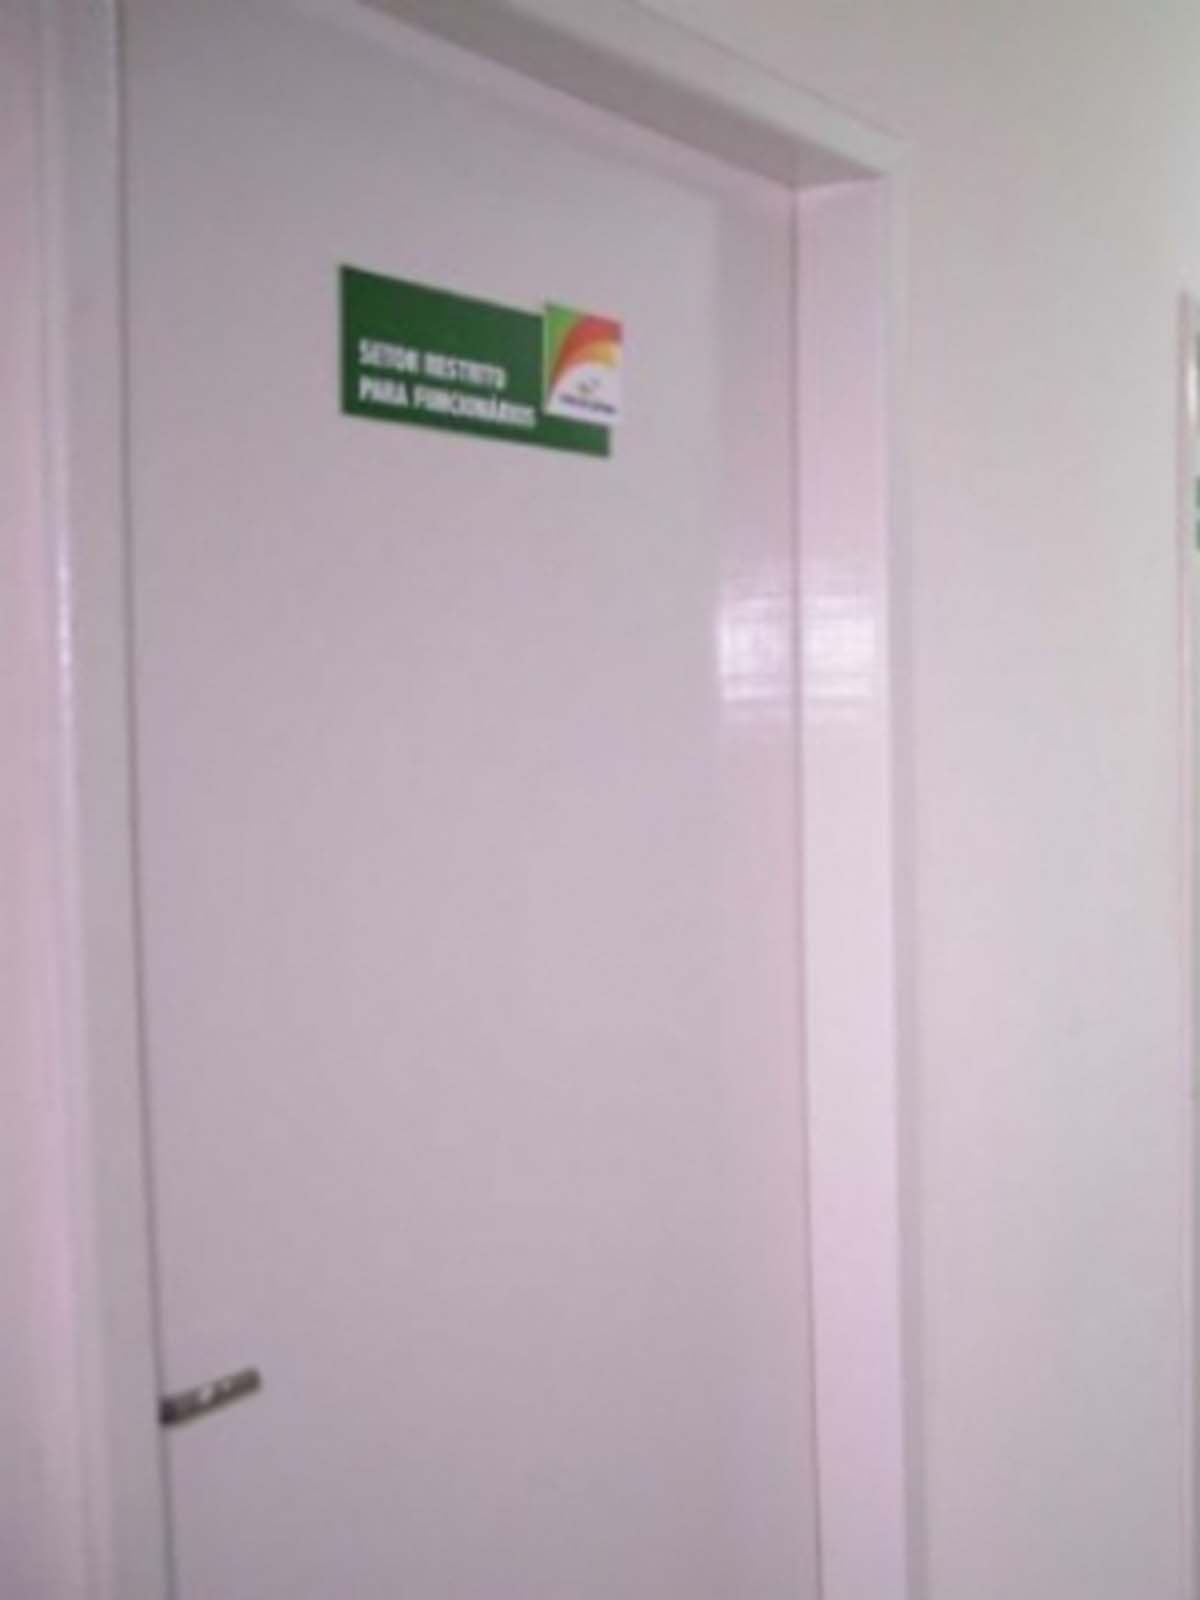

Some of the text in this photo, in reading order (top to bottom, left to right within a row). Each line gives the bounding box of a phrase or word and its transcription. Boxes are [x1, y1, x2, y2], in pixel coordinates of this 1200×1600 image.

[359, 337, 506, 391] SETOR RESTRITO
[358, 373, 409, 407] PARA
[412, 382, 537, 429] FUNCIONÁRIOS
